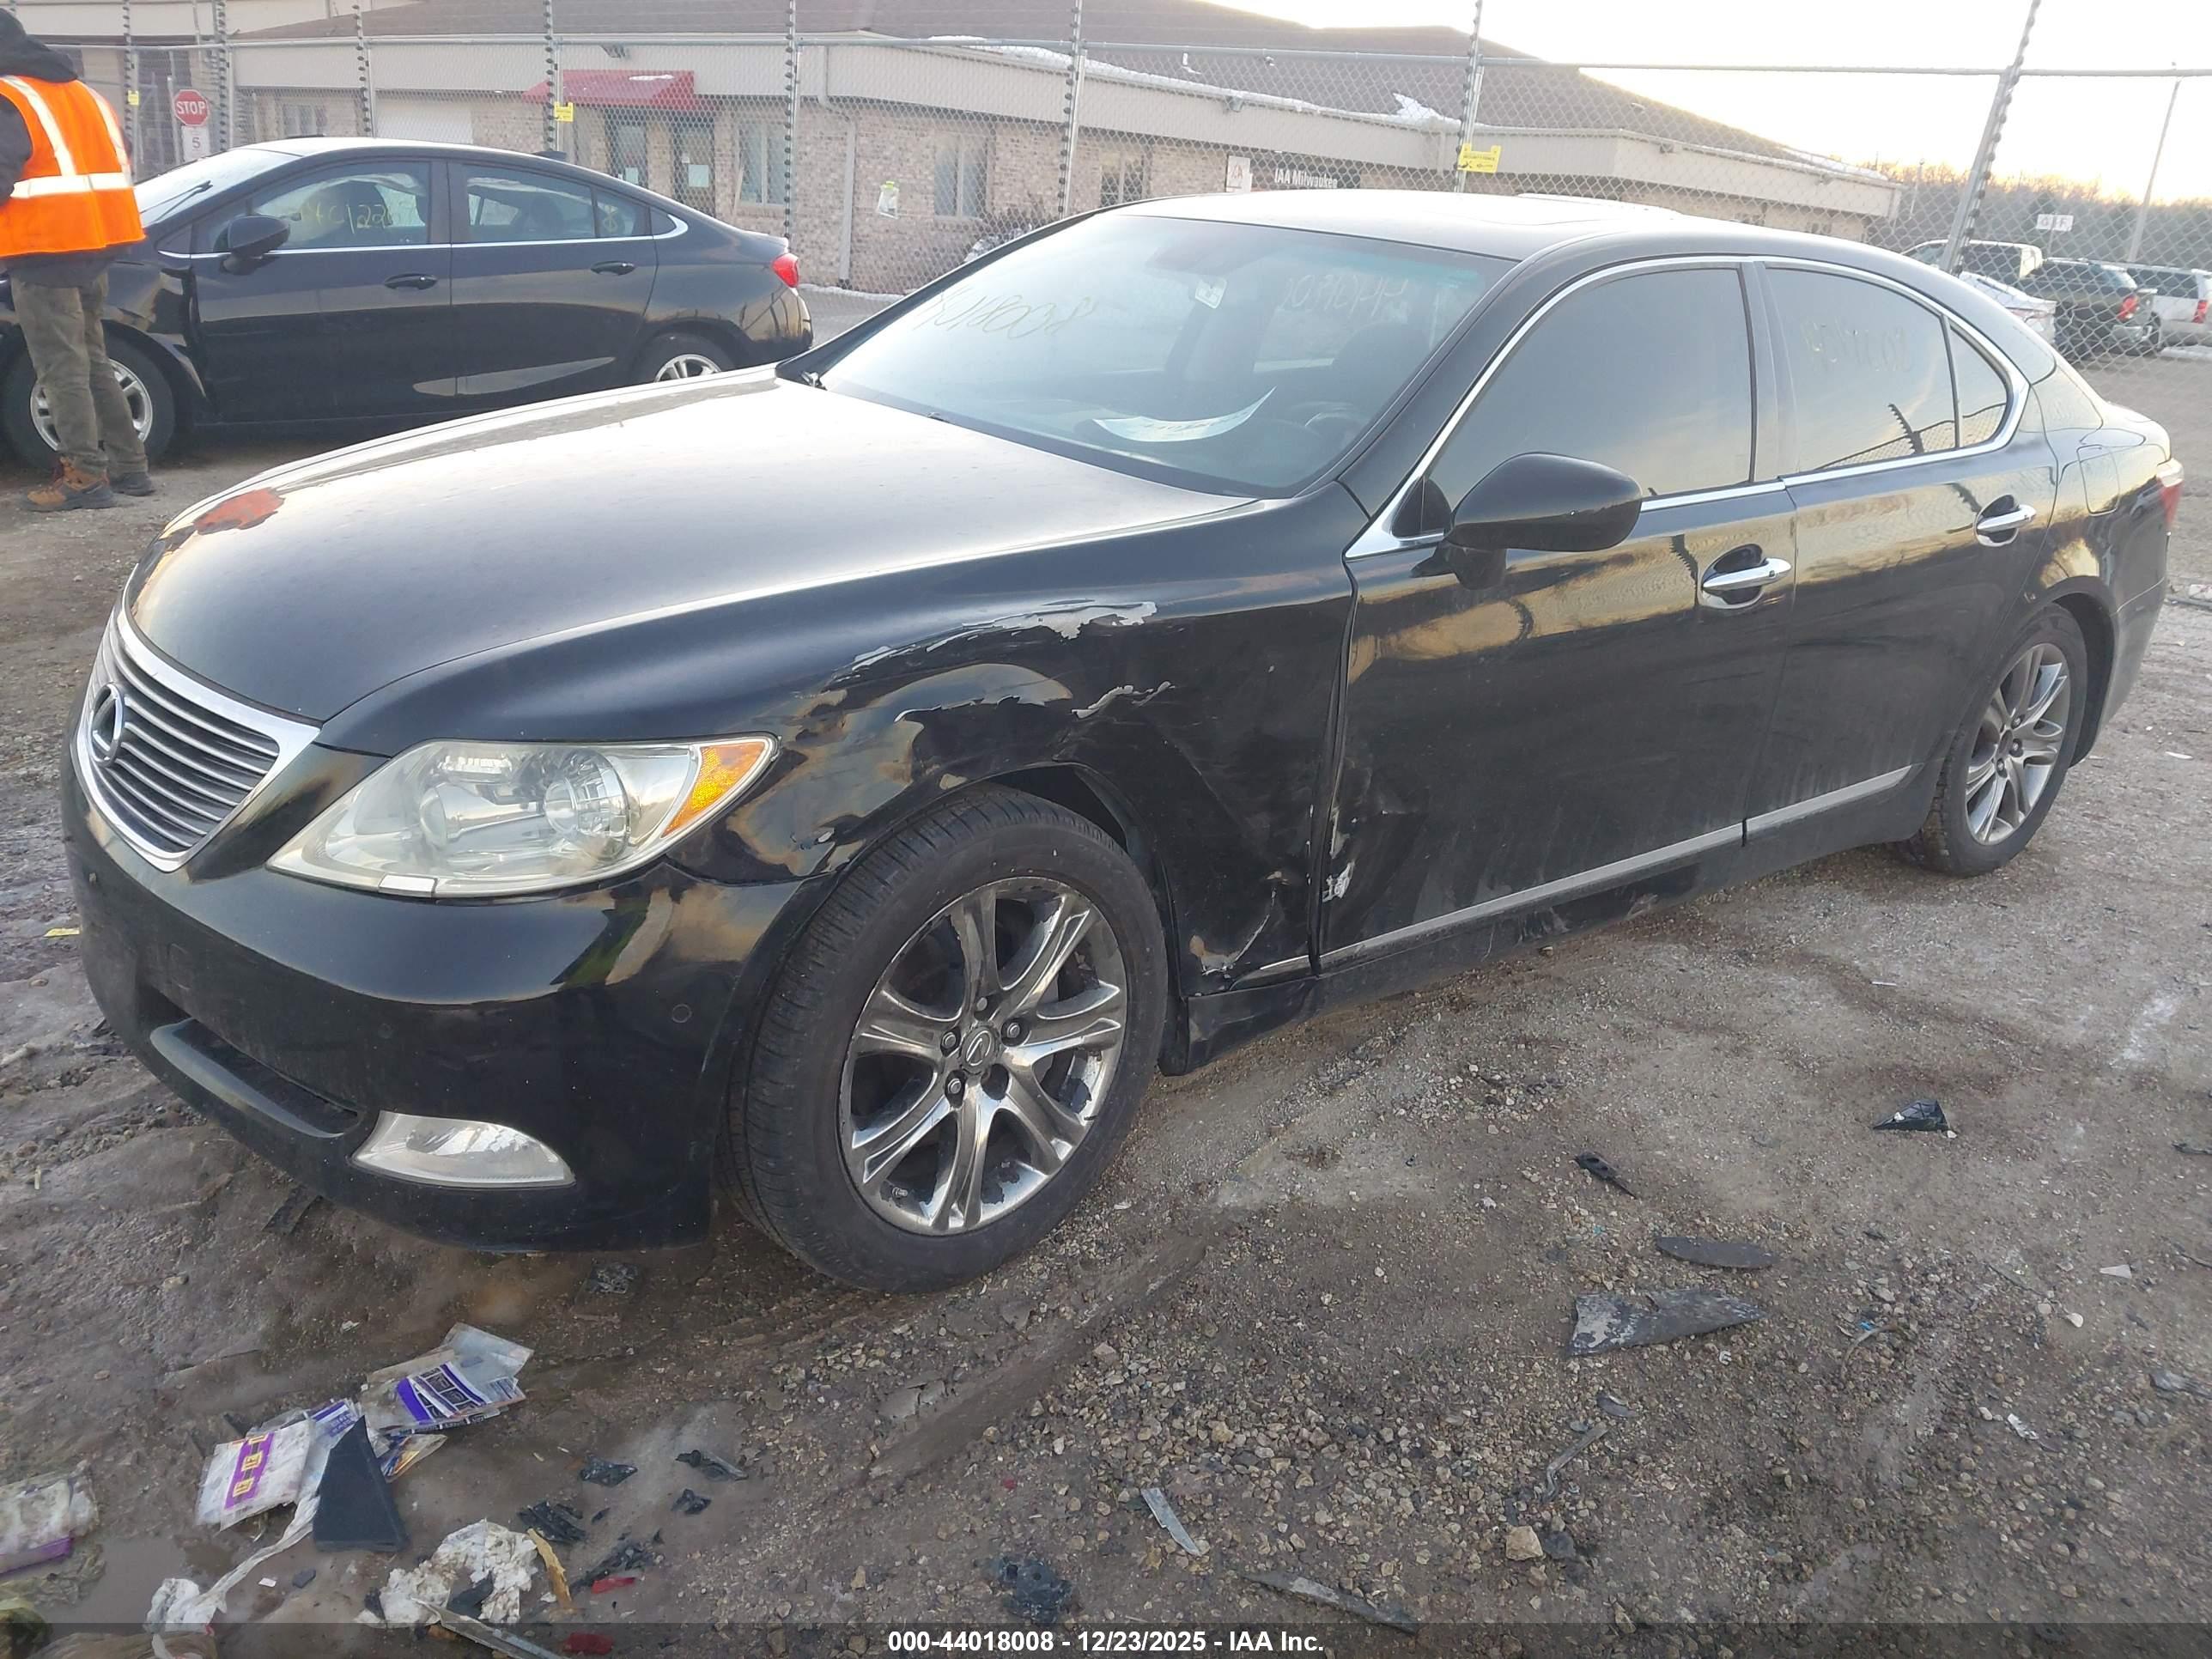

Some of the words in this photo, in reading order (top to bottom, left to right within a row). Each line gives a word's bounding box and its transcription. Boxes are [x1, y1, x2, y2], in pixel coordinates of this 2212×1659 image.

[176, 100, 206, 115] STOP
[1274, 167, 1291, 184] IAA
[1291, 170, 1339, 189] Milwaukee
